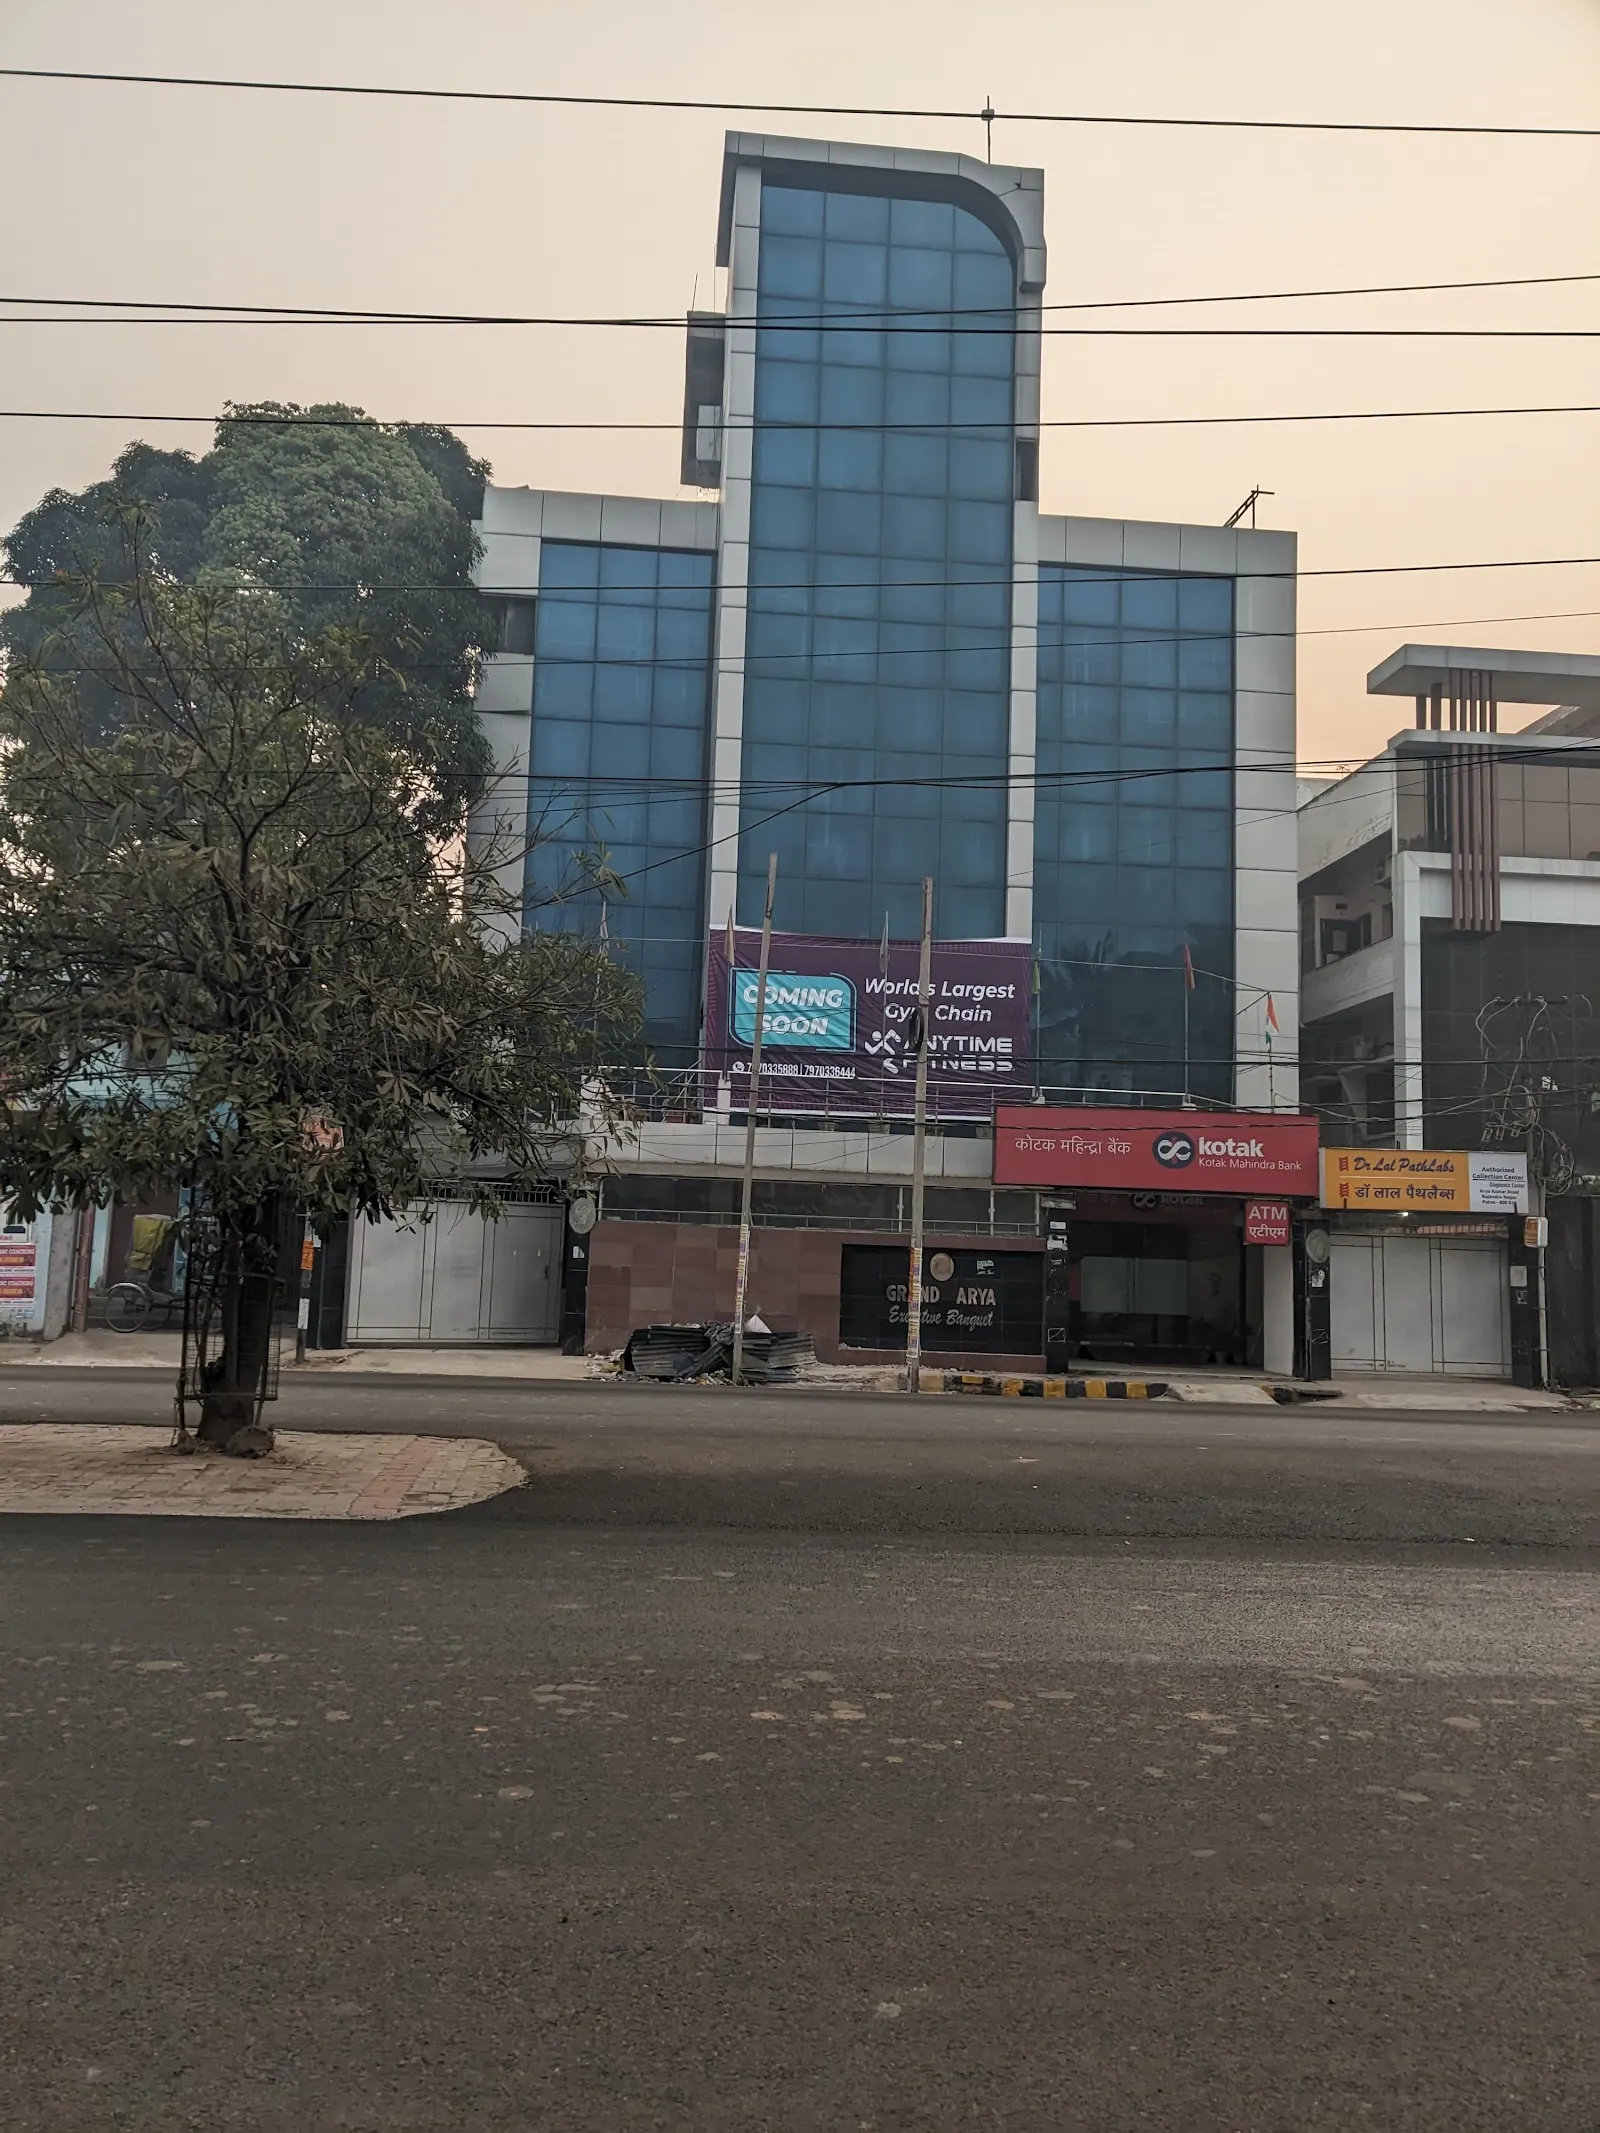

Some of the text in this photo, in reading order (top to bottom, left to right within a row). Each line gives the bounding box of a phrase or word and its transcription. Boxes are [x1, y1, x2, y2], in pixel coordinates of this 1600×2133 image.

[743, 984, 843, 1008] COMING
[865, 978, 1016, 1001] Worlds Largest
[935, 1004, 992, 1022] Chain
[903, 1035, 1013, 1053] NYTIME
[1014, 1133, 1132, 1155] कोटक महिन्द्रा बैंक
[1199, 1137, 1265, 1158] kotak
[1199, 1157, 1302, 1171] Kotak Mahindra Bank
[1354, 1156, 1455, 1173] Dr Lal PathLabs
[1373, 1187, 1401, 1199] लाल
[1248, 1205, 1287, 1220] ATM
[1248, 1223, 1287, 1239] एटीएम
[886, 1284, 997, 1306] GRND ARYA
[946, 1309, 994, 1332] Banquet
